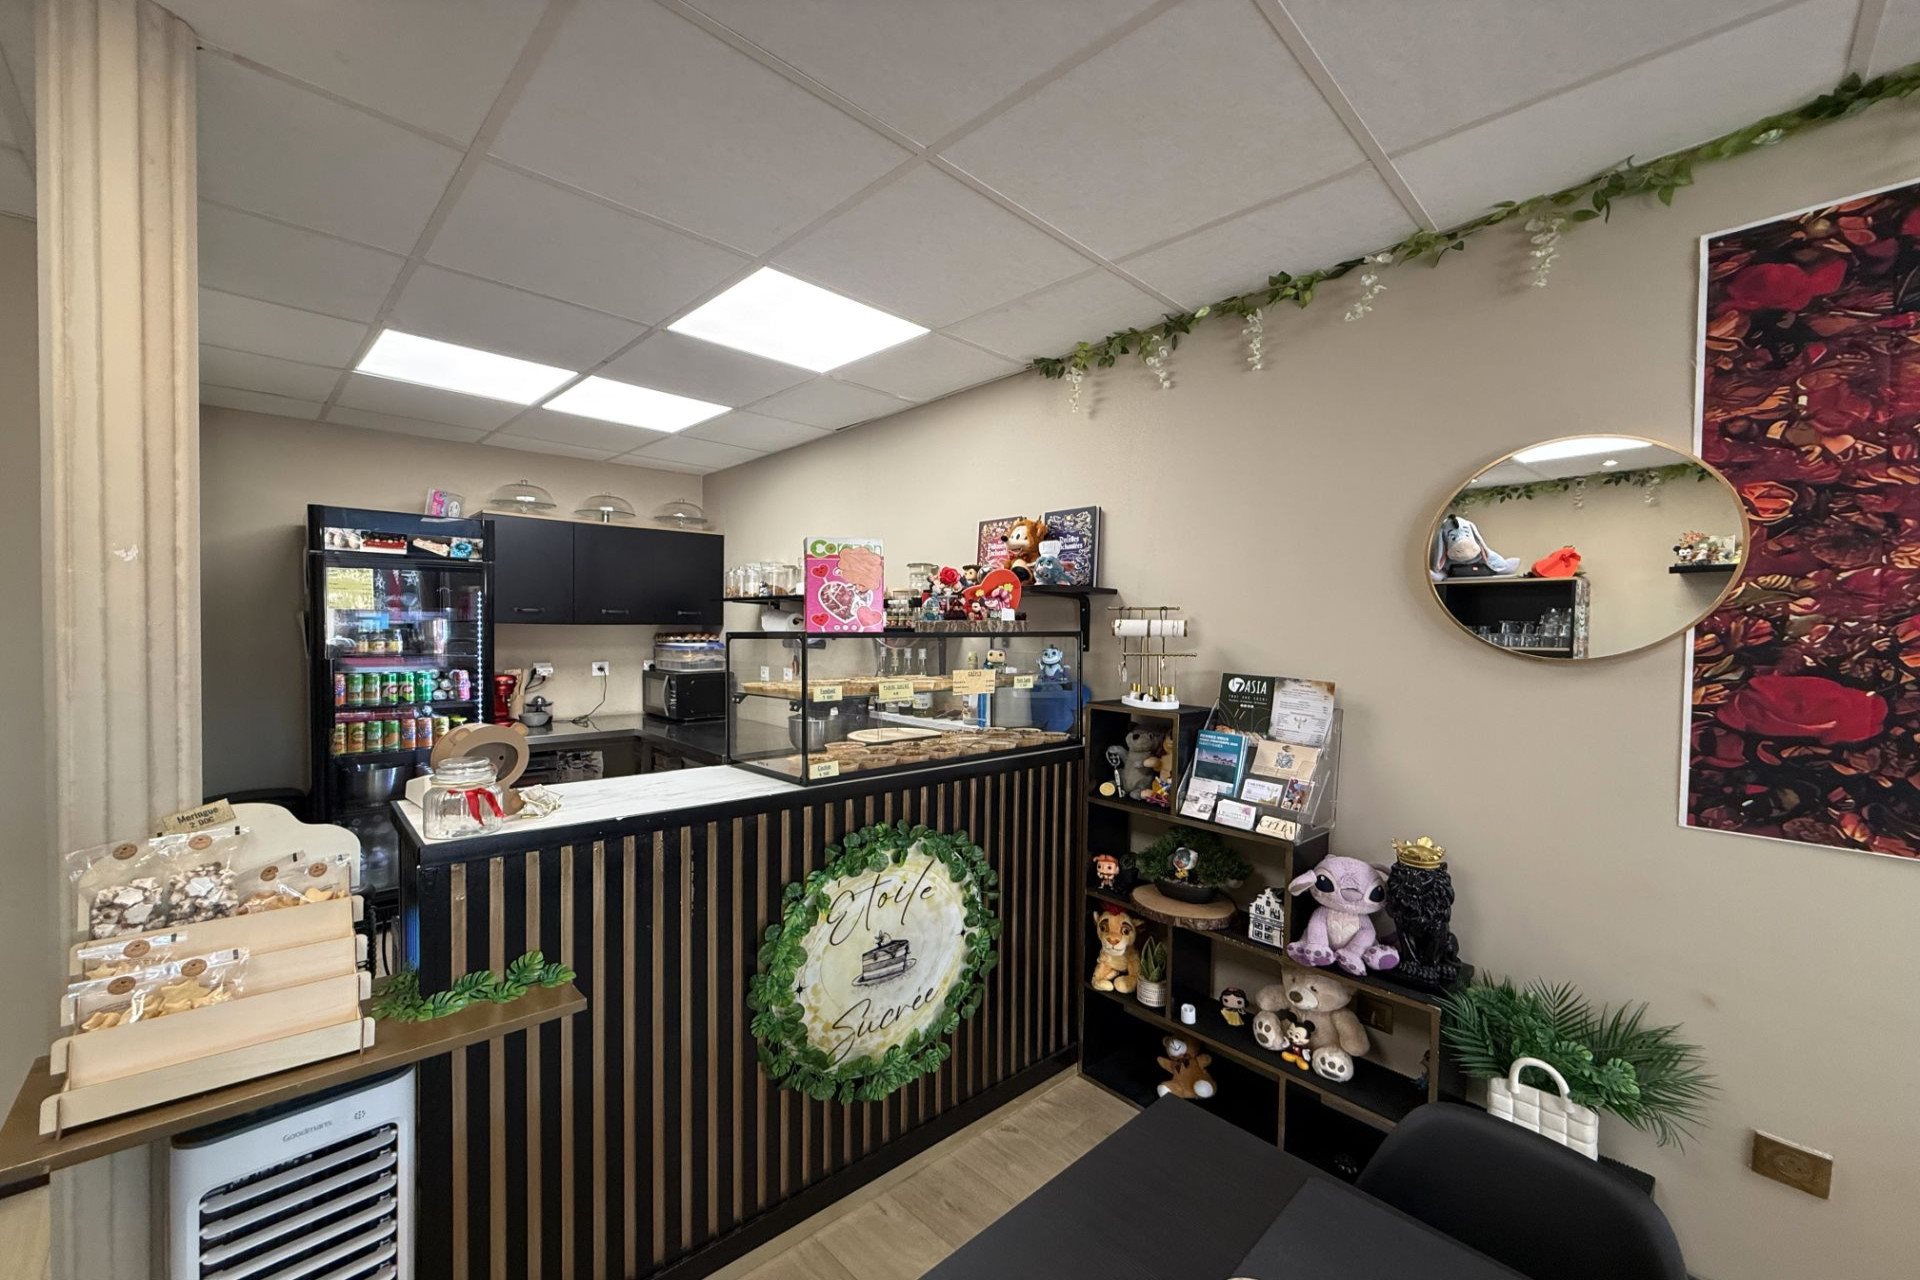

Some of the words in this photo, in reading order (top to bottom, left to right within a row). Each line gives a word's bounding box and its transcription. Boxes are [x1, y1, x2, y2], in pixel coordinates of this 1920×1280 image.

[1244, 680, 1267, 695] ASIA
[177, 807, 218, 824] Meringue
[827, 860, 936, 946] Étoile
[827, 985, 938, 1065] Sucrée
[282, 1121, 332, 1142] Goodmans
